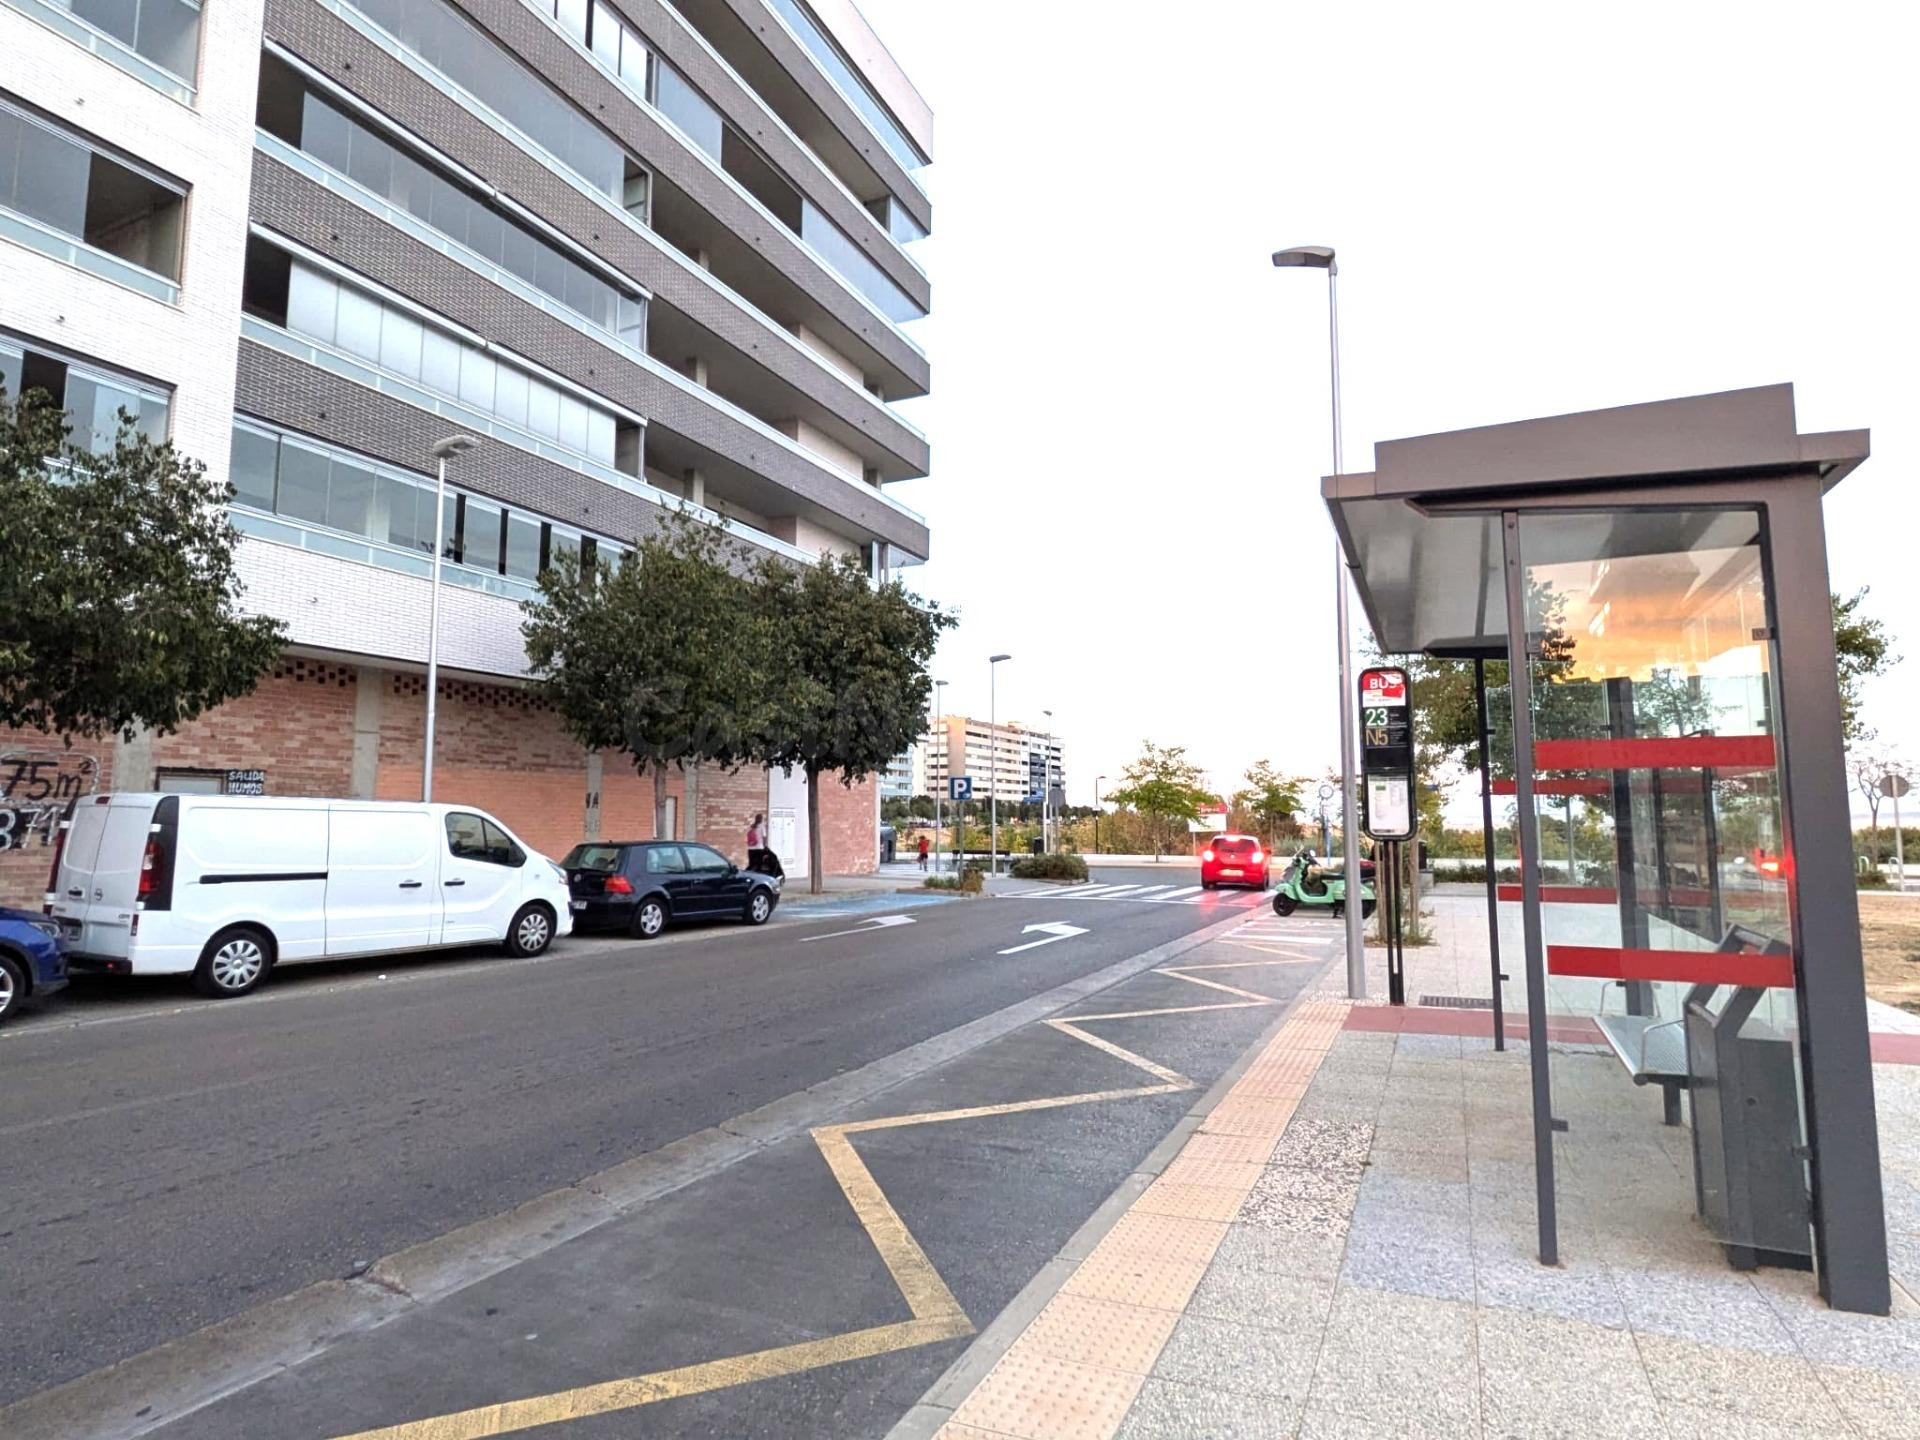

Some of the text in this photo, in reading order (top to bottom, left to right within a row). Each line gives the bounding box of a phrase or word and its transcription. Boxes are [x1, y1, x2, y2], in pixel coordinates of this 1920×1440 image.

[1366, 708, 1388, 726] 23
[1365, 729, 1389, 746] N5
[228, 771, 265, 781] SALIDA
[953, 779, 968, 799] P
